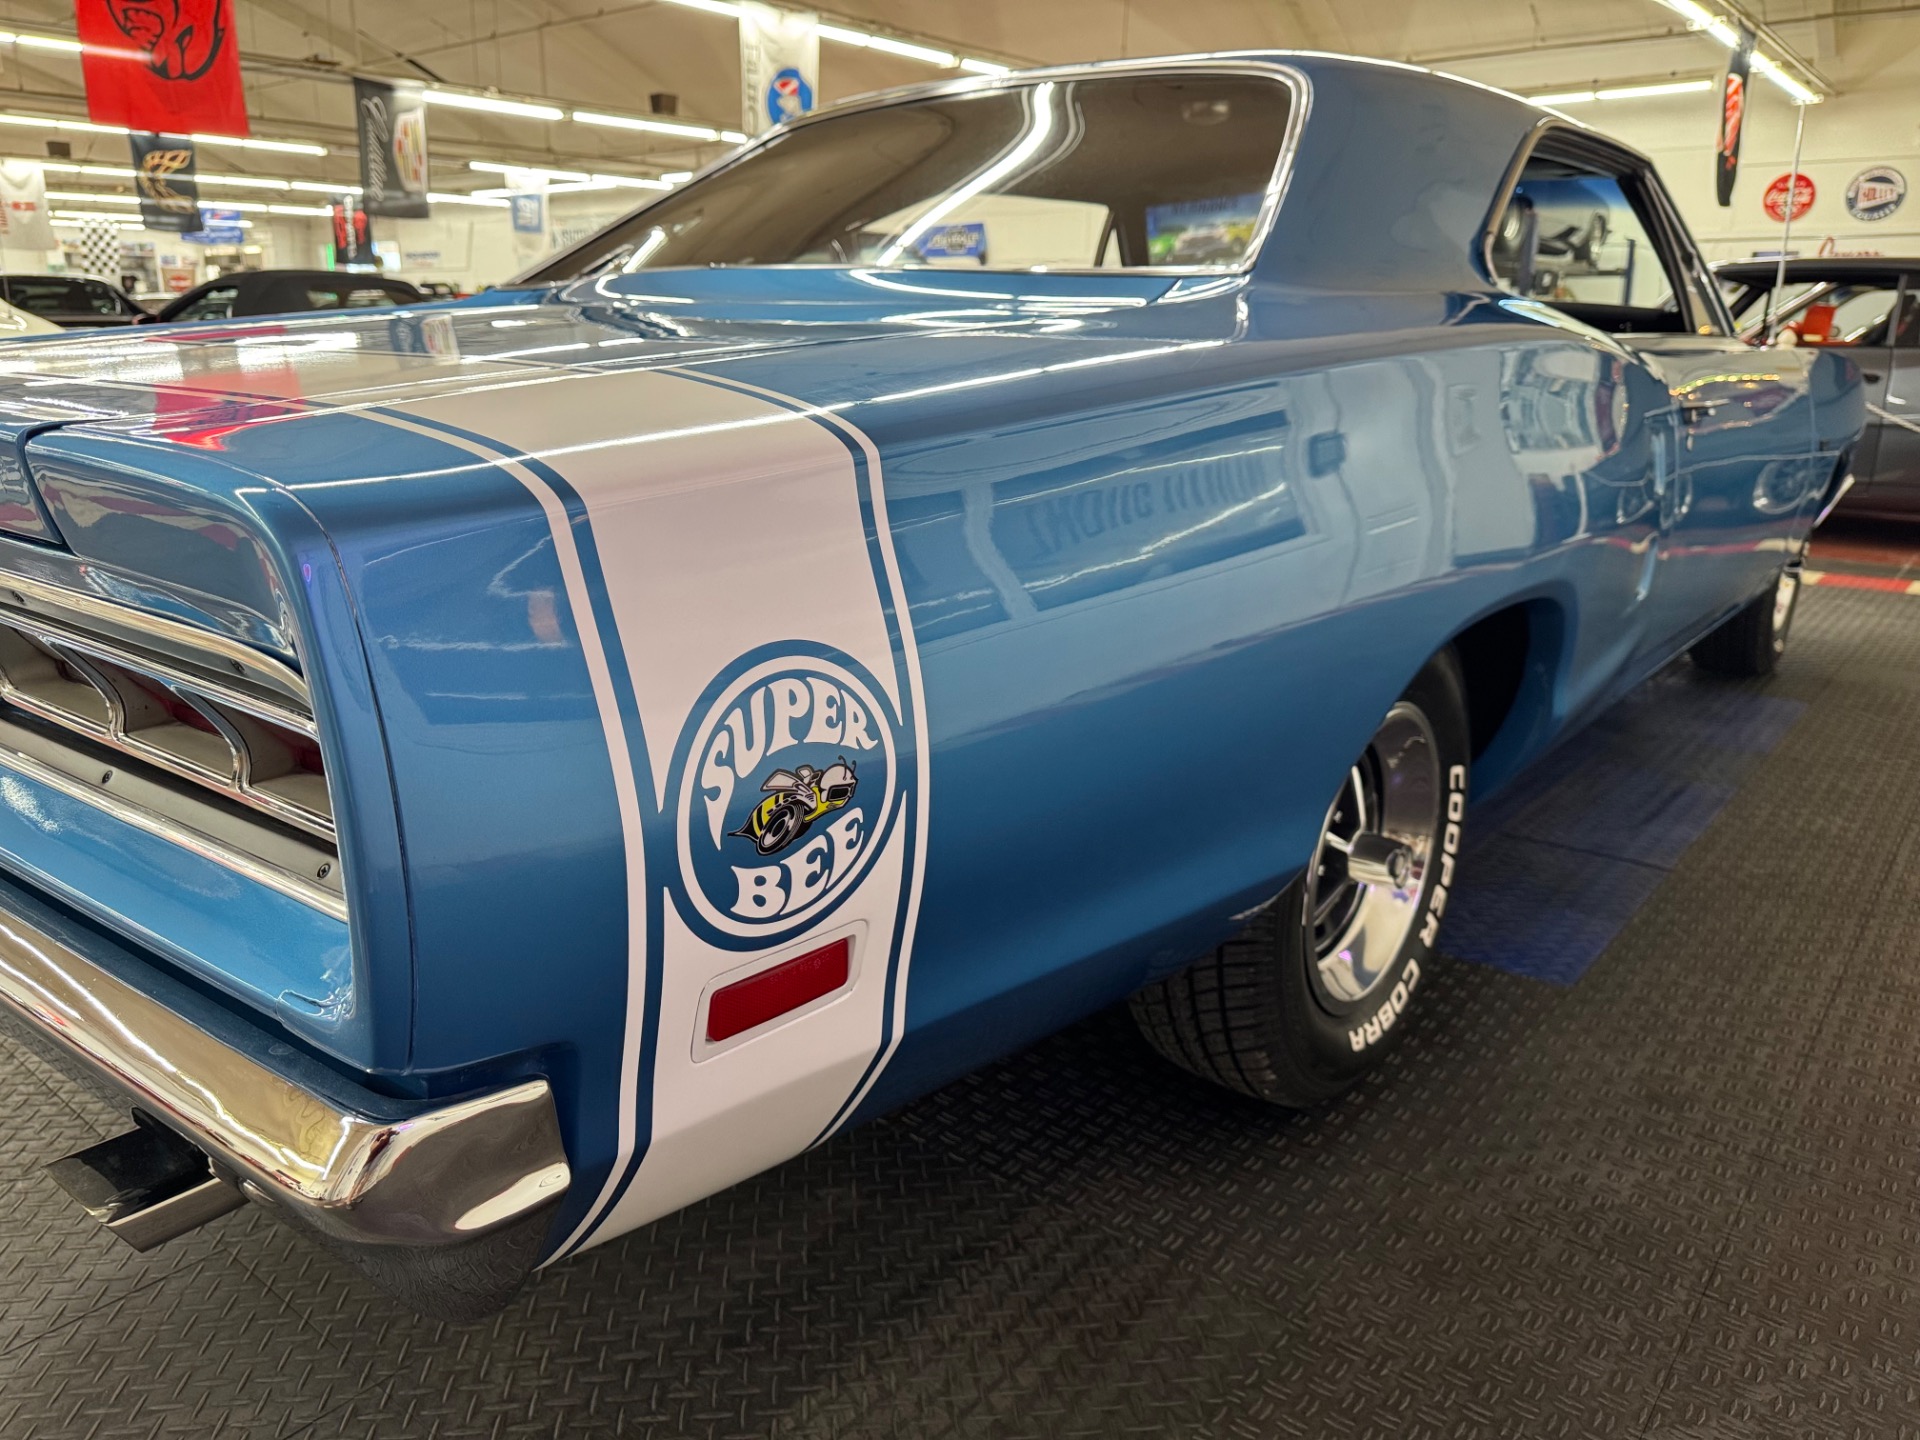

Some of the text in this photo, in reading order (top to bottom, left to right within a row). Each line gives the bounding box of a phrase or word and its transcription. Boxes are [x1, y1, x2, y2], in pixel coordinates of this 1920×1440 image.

[701, 677, 878, 851] SUPER
[730, 807, 864, 918] BEE
[1419, 765, 1465, 947] COOPER
[1348, 958, 1421, 1051] COBRA
